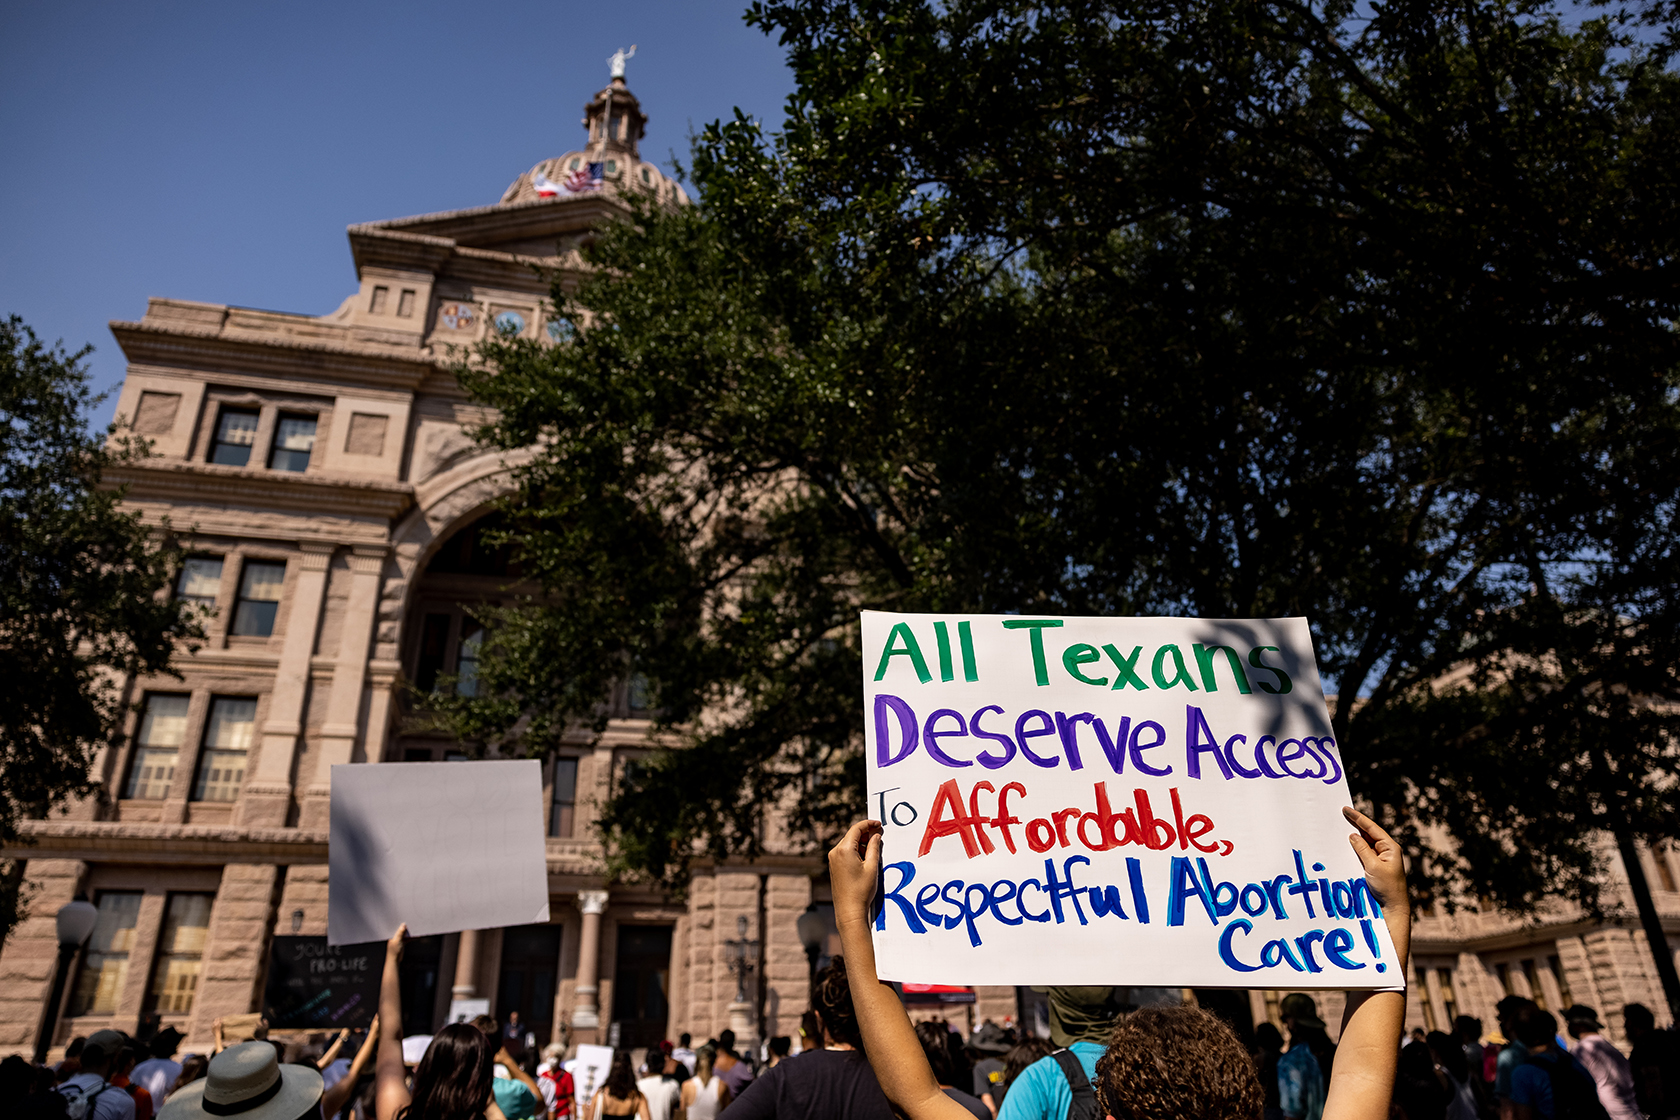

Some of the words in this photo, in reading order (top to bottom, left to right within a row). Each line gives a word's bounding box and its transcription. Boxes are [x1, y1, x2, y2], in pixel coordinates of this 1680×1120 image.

[873, 620, 979, 685] All
[1001, 619, 1293, 695] Texans
[873, 694, 1173, 777] Deserve
[1185, 704, 1342, 785] Access
[872, 787, 918, 827] To
[918, 778, 1234, 859] Affordable,
[875, 855, 1151, 948] Respectful
[1166, 848, 1385, 928] Abortion
[1217, 918, 1388, 975] Care!
